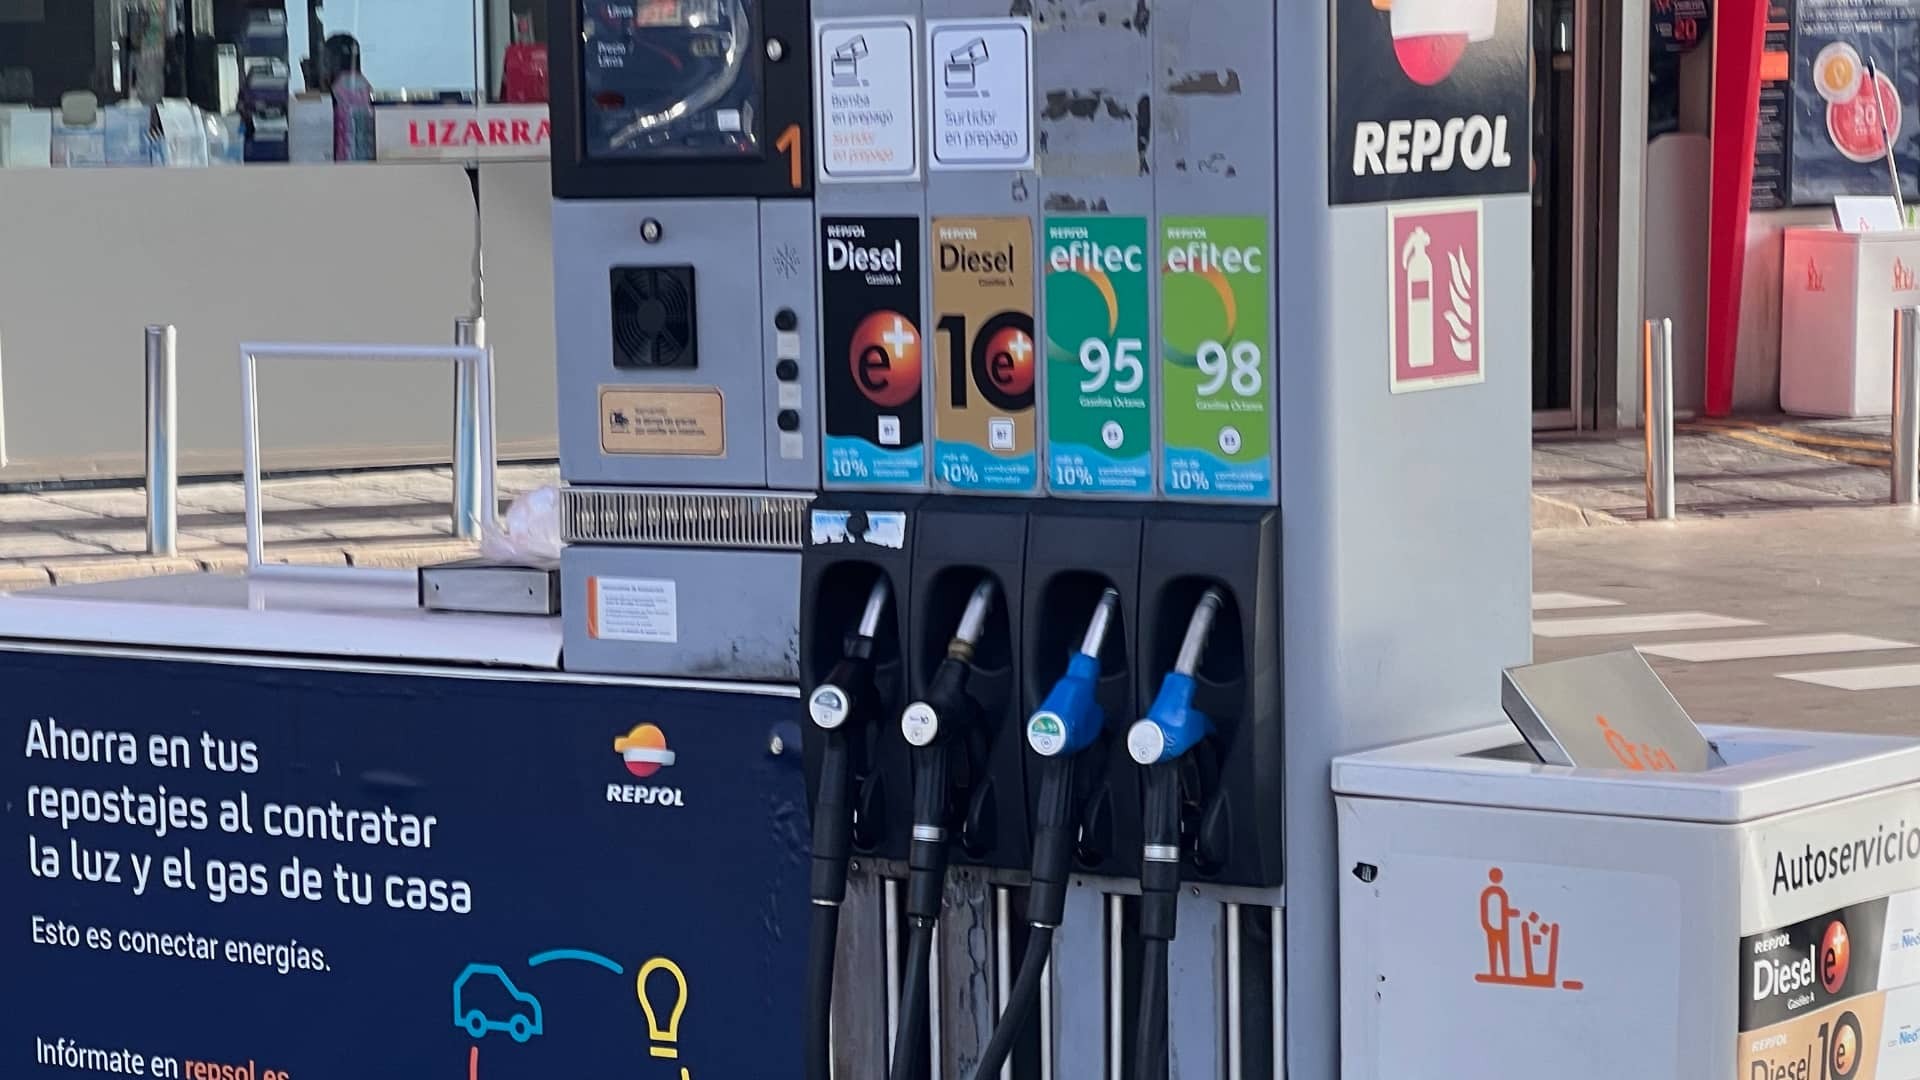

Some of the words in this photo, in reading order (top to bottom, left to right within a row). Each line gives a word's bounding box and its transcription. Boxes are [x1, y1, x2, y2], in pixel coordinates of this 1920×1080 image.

[945, 109, 996, 127] Surtidor
[776, 123, 802, 189] 1
[945, 133, 961, 147] en
[965, 131, 1018, 149] prepago
[1352, 114, 1511, 176] REPSOL
[827, 239, 902, 272] Diesel
[940, 243, 1014, 273] Diesel
[1050, 240, 1142, 273] efitec
[1168, 241, 1262, 274] efitec
[1079, 337, 1144, 394] 95
[1196, 340, 1262, 396] 98
[832, 457, 868, 478] 10%
[942, 461, 978, 484] 10%
[1057, 465, 1093, 486] 10%
[1172, 470, 1209, 490] 10%
[25, 717, 137, 765] Ahorra
[149, 734, 190, 769] en
[201, 730, 259, 773] tus
[606, 783, 684, 807] REPSOL
[27, 785, 208, 837] repostajes
[219, 791, 252, 834] al
[264, 800, 436, 848] contratar
[29, 835, 60, 878] la
[71, 838, 121, 883] luz
[131, 853, 151, 895] y
[163, 847, 195, 890] el
[206, 858, 268, 902] gas
[280, 856, 322, 900] de
[335, 862, 372, 905] tu
[385, 873, 472, 914] casa
[1772, 820, 1920, 896] Autoservicio
[32, 915, 80, 947] Esto
[86, 926, 112, 950] es
[118, 930, 218, 960] conectar
[225, 939, 331, 974] energías.
[1754, 933, 1790, 954] REPSOL
[1753, 944, 1815, 1001] Diesel
[37, 1036, 145, 1075] Infórmate
[151, 1055, 178, 1079] en
